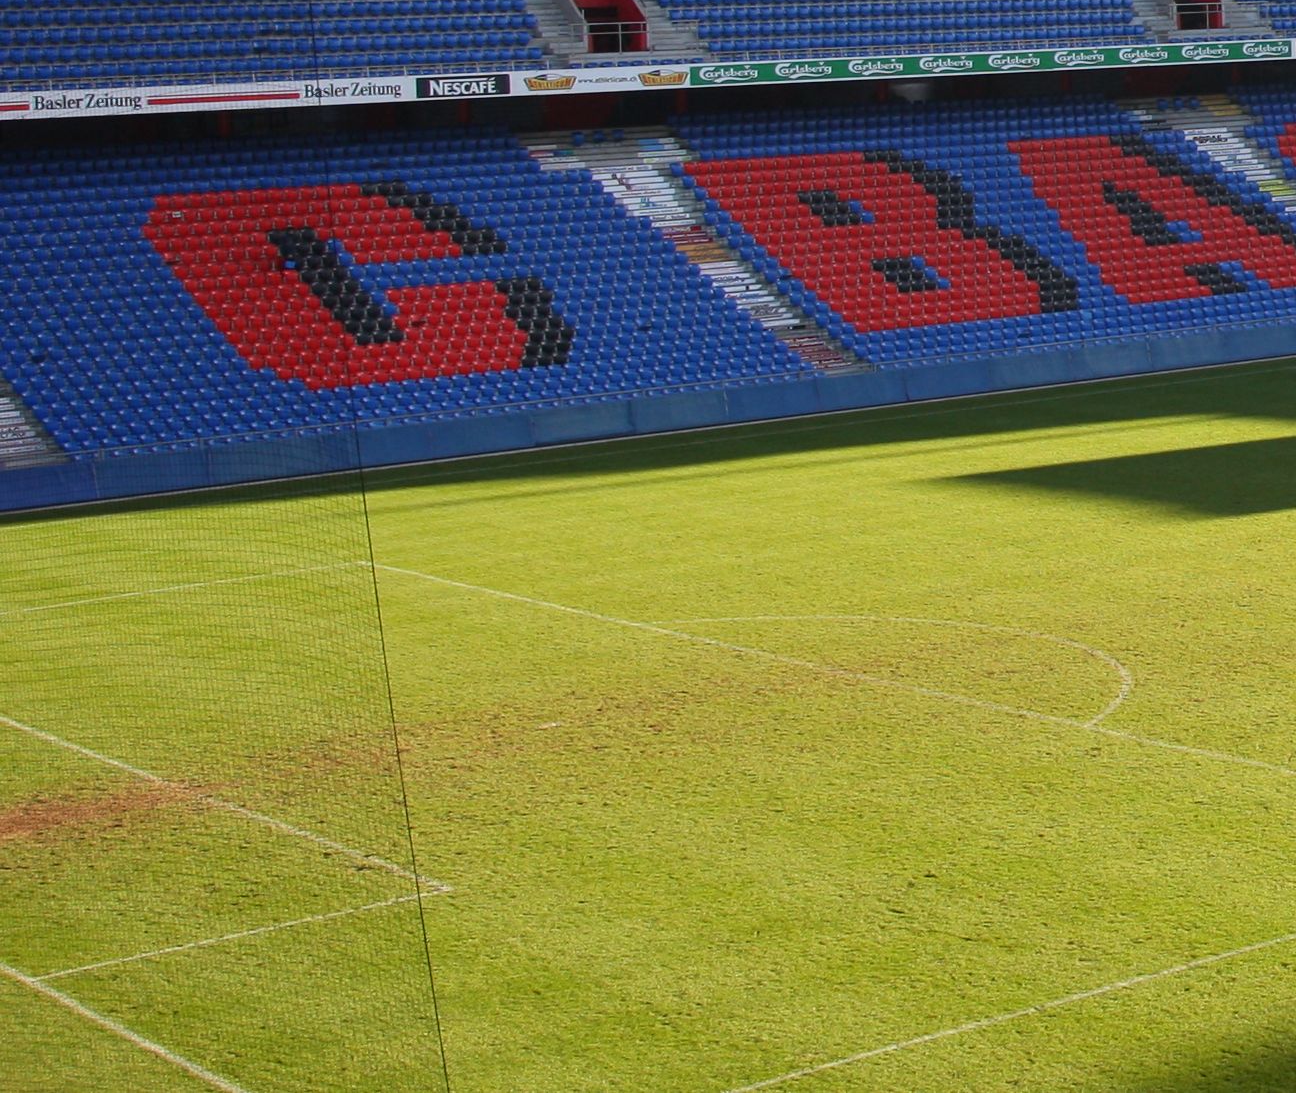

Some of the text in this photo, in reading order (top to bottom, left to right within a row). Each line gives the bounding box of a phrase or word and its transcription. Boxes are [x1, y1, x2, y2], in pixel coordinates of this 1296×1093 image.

[699, 41, 1289, 83] Carlsberg Carlsberg Carlsberg Carlsberg Carlsberg Carlsberg Carlsberg Carlsberg Carlsberg
[304, 82, 402, 99] Basler Zeitung
[430, 77, 497, 96] NESCAFÉ
[33, 93, 143, 111] Basler Zeitung
